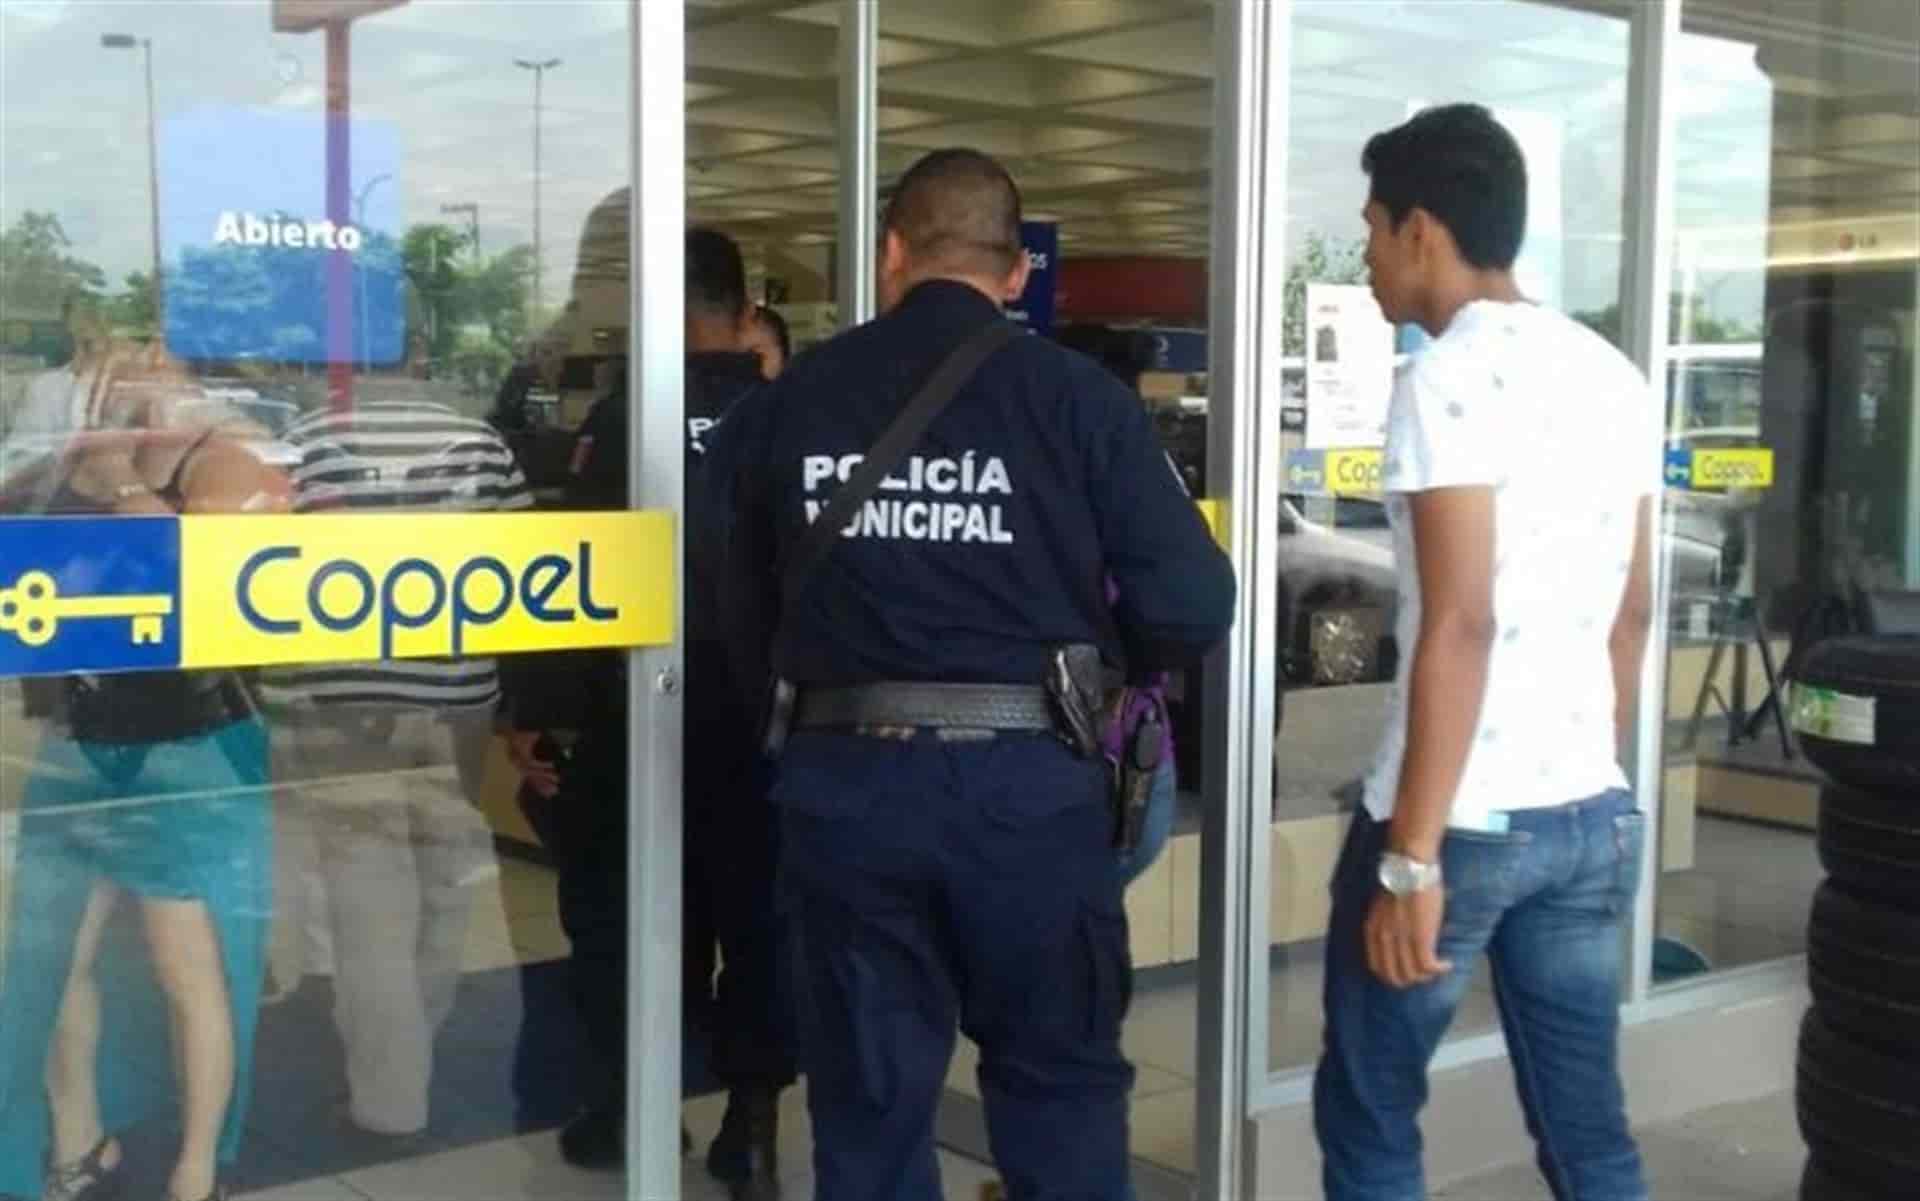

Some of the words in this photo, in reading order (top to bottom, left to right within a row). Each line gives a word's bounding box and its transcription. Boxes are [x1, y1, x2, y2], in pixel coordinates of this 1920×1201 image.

[215, 211, 361, 250] Abierto
[1337, 456, 1380, 488] Cop
[804, 500, 1013, 543] NICIPAL
[236, 541, 618, 660] Coppel
